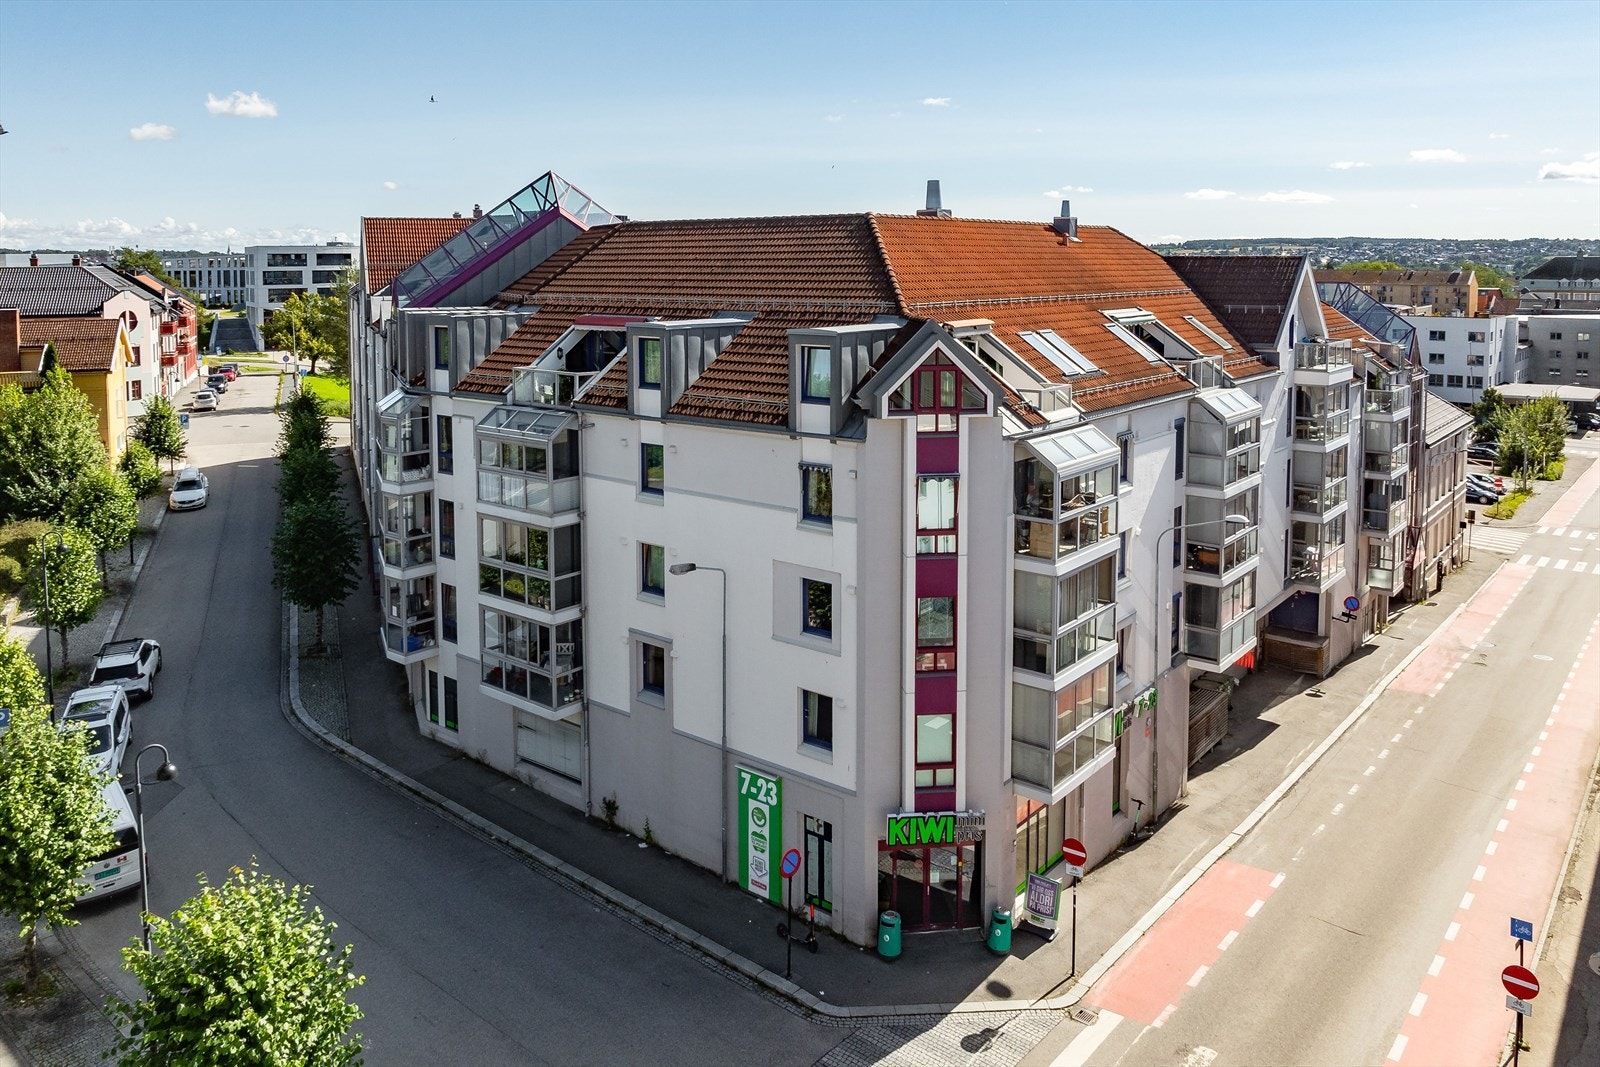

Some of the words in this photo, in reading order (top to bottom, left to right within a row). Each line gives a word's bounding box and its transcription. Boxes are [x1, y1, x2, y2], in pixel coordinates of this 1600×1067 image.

[740, 772, 778, 806] 7-23
[956, 811, 986, 829] mini
[888, 814, 956, 847] KIWI
[956, 827, 984, 845] pris
[1030, 890, 1053, 907] ALDRI
